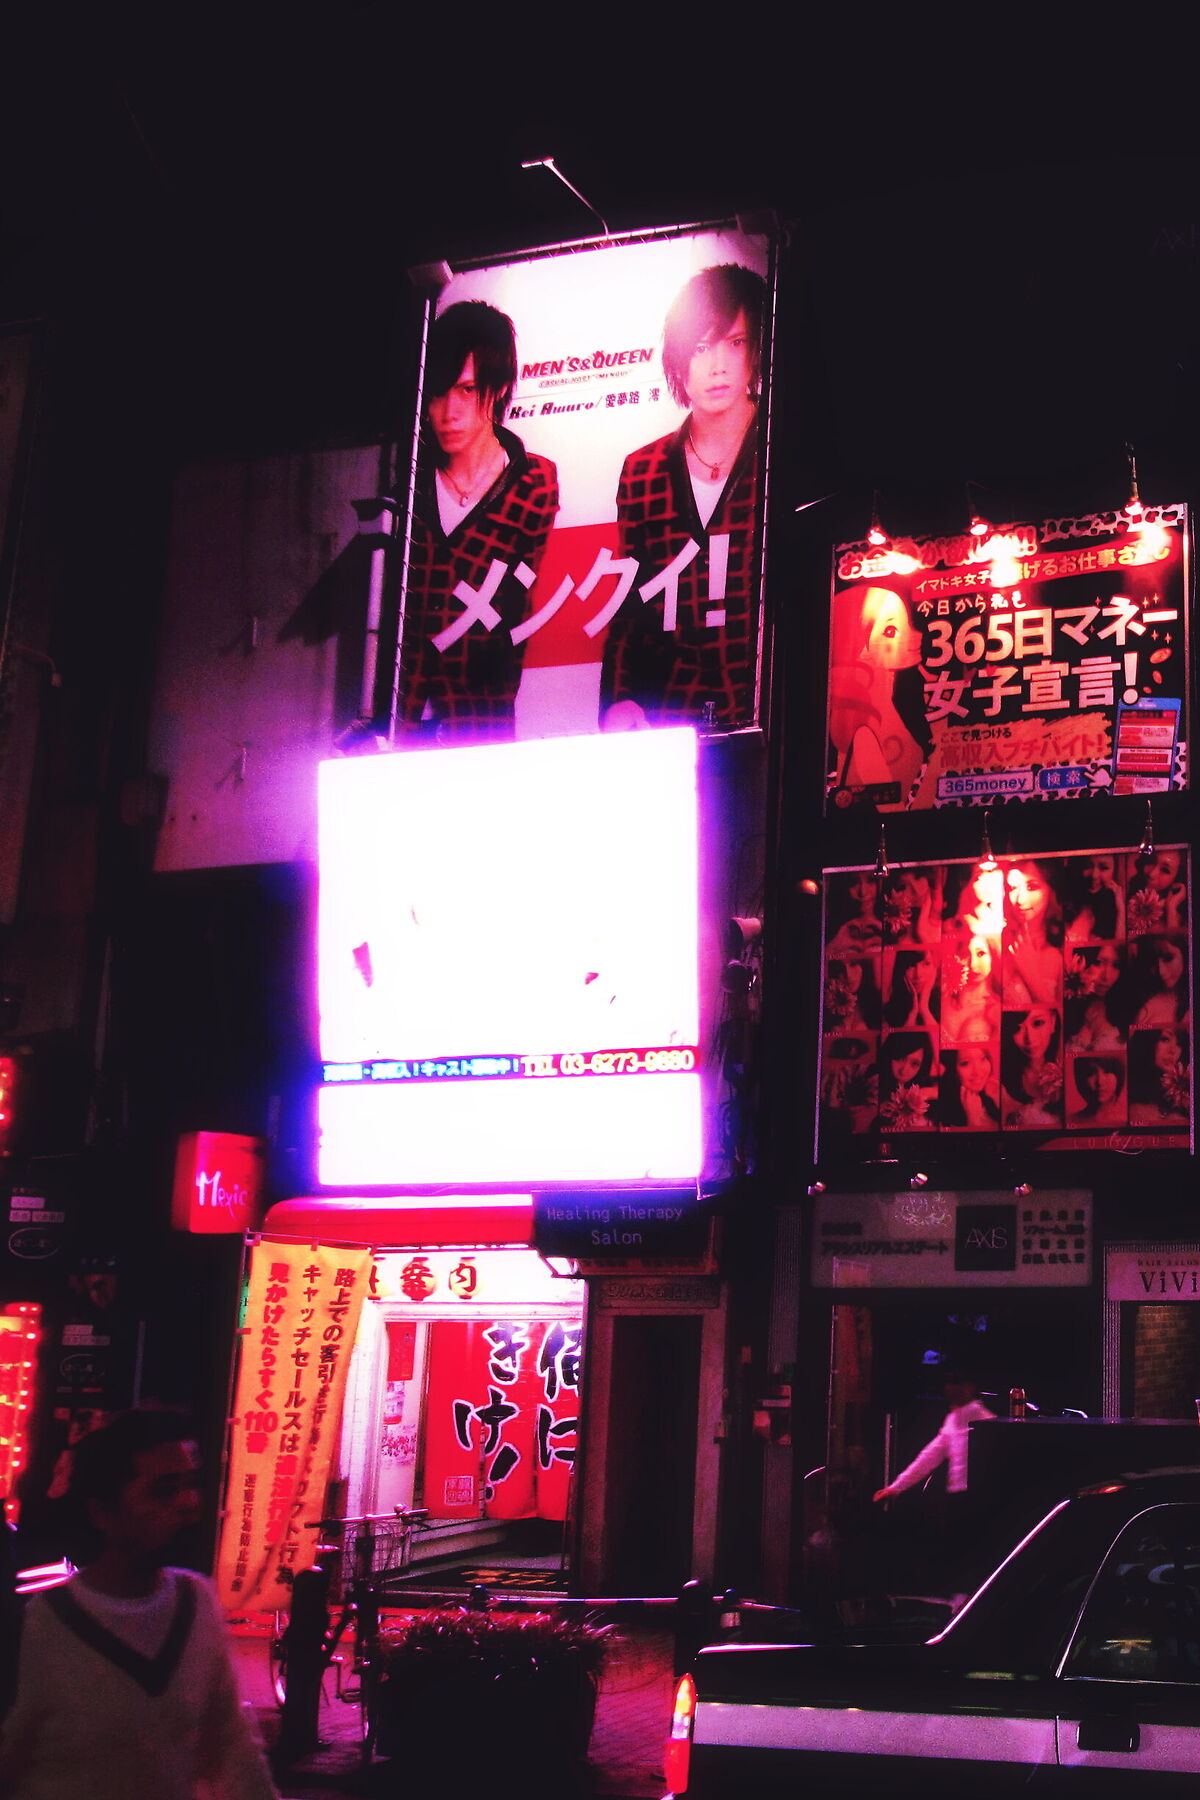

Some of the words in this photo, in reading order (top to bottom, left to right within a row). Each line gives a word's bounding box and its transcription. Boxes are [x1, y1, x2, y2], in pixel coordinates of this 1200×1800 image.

[431, 533, 730, 653] メンクイ!
[925, 595, 1178, 668] 365日マネー
[922, 652, 1139, 723] 女子宣言!
[940, 728, 1012, 745] ここで見つける
[945, 776, 1028, 795] 365money
[521, 1054, 558, 1077] TEL
[547, 1204, 610, 1223] Healing
[618, 1203, 683, 1223] Therapy
[591, 1229, 643, 1246] Salon
[964, 1227, 1007, 1249] AXIS
[1140, 1270, 1199, 1293] ViVi
